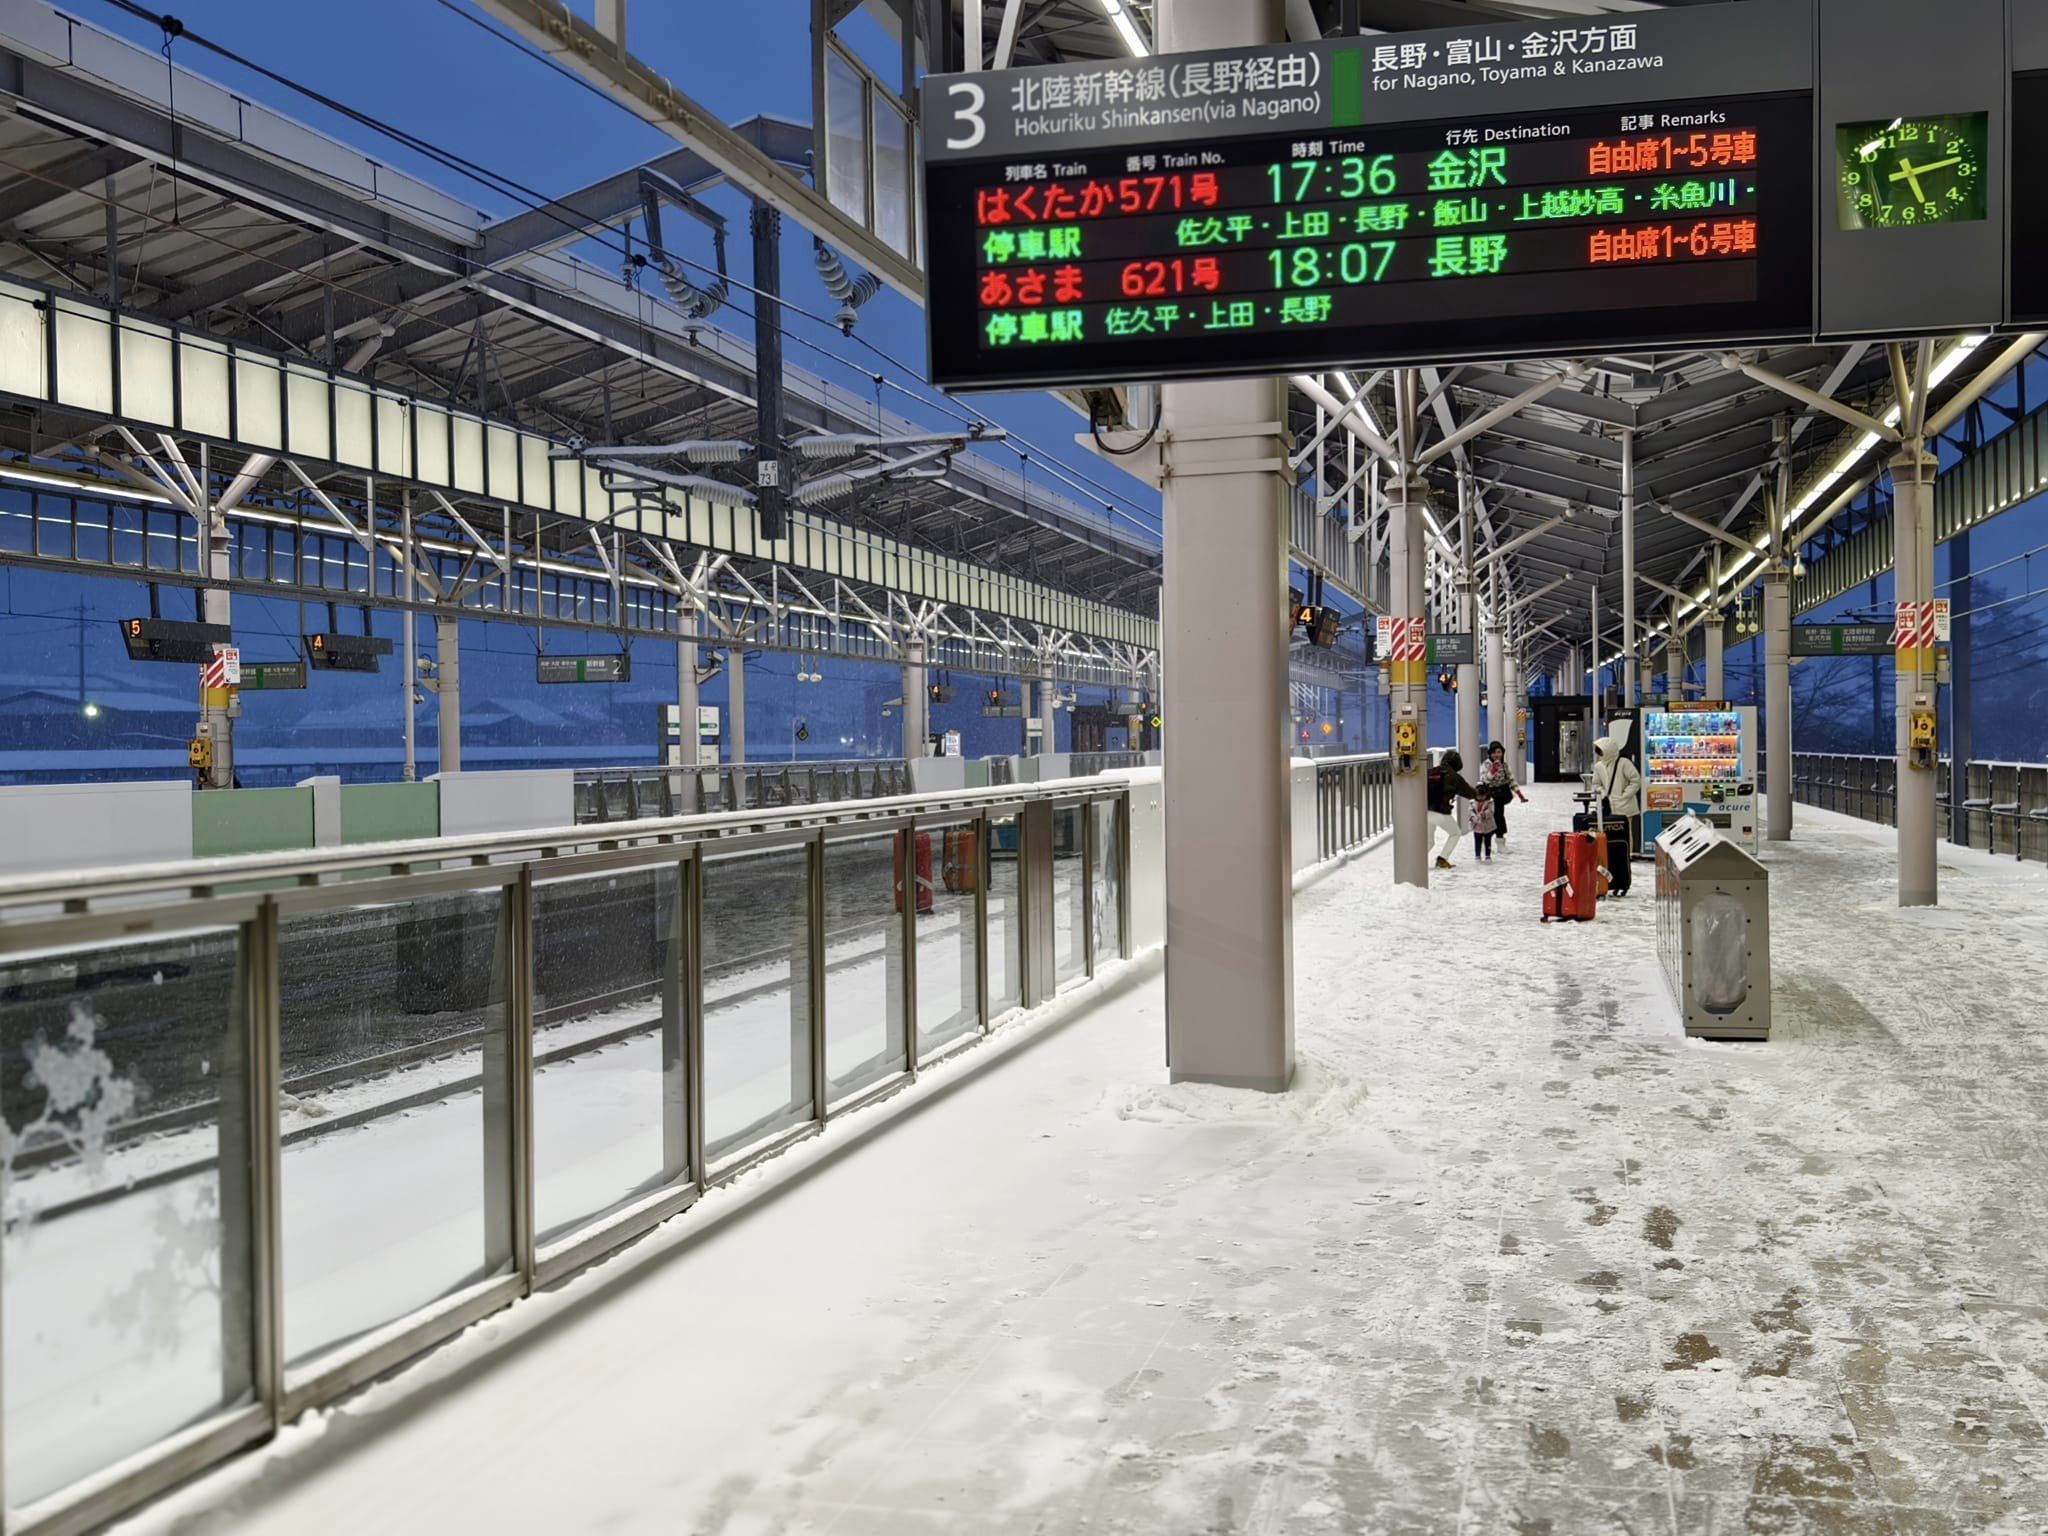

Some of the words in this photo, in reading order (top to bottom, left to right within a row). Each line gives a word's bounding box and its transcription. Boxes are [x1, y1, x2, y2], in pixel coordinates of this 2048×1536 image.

[1371, 23, 1637, 73] 長野・富山・金沢方面
[1372, 76, 1398, 91] for
[1403, 72, 1476, 92] Nagano,
[1480, 65, 1547, 84] Toyama
[1553, 61, 1566, 75] &
[1572, 54, 1664, 75] Kanazawa
[946, 82, 987, 150] 3
[1014, 112, 1096, 137] Hokuriku
[1242, 91, 1321, 120] Nagano)
[1898, 127, 1919, 141] 12
[1927, 130, 1936, 143] 1
[1004, 163, 1048, 182] 列車名
[1053, 162, 1087, 177] Train
[1126, 155, 1157, 173] 番号
[1162, 152, 1197, 169] Train
[1201, 152, 1225, 166] No.
[1291, 141, 1323, 158] 時刻
[1329, 140, 1366, 155] Time
[1445, 128, 1478, 146] 行先
[1484, 123, 1571, 142] Destination
[1620, 114, 1654, 132] 記事
[1660, 111, 1726, 128] Remarks
[1946, 141, 1960, 154] 2
[1957, 163, 1971, 176] 3
[977, 180, 1115, 225] はくたか
[1119, 171, 1219, 214] 571号
[1266, 154, 1397, 204] 17:36
[1427, 147, 1507, 192] 金沢
[1847, 172, 1861, 185] 9
[1859, 193, 1873, 207] 8
[1945, 186, 1960, 200] 4
[1880, 205, 1894, 219] 7
[1902, 206, 1915, 220] 6
[1924, 201, 1937, 215] 5
[982, 227, 1082, 263] 停車駅
[980, 264, 1083, 306] あさま
[1121, 257, 1220, 297] 621号
[1268, 240, 1397, 289] 18:07
[1427, 234, 1508, 278] 長野
[985, 310, 1084, 346] 停車駅
[1300, 607, 1312, 622] 4
[131, 620, 140, 635] 5
[314, 635, 323, 648] 4
[612, 660, 623, 675] 2
